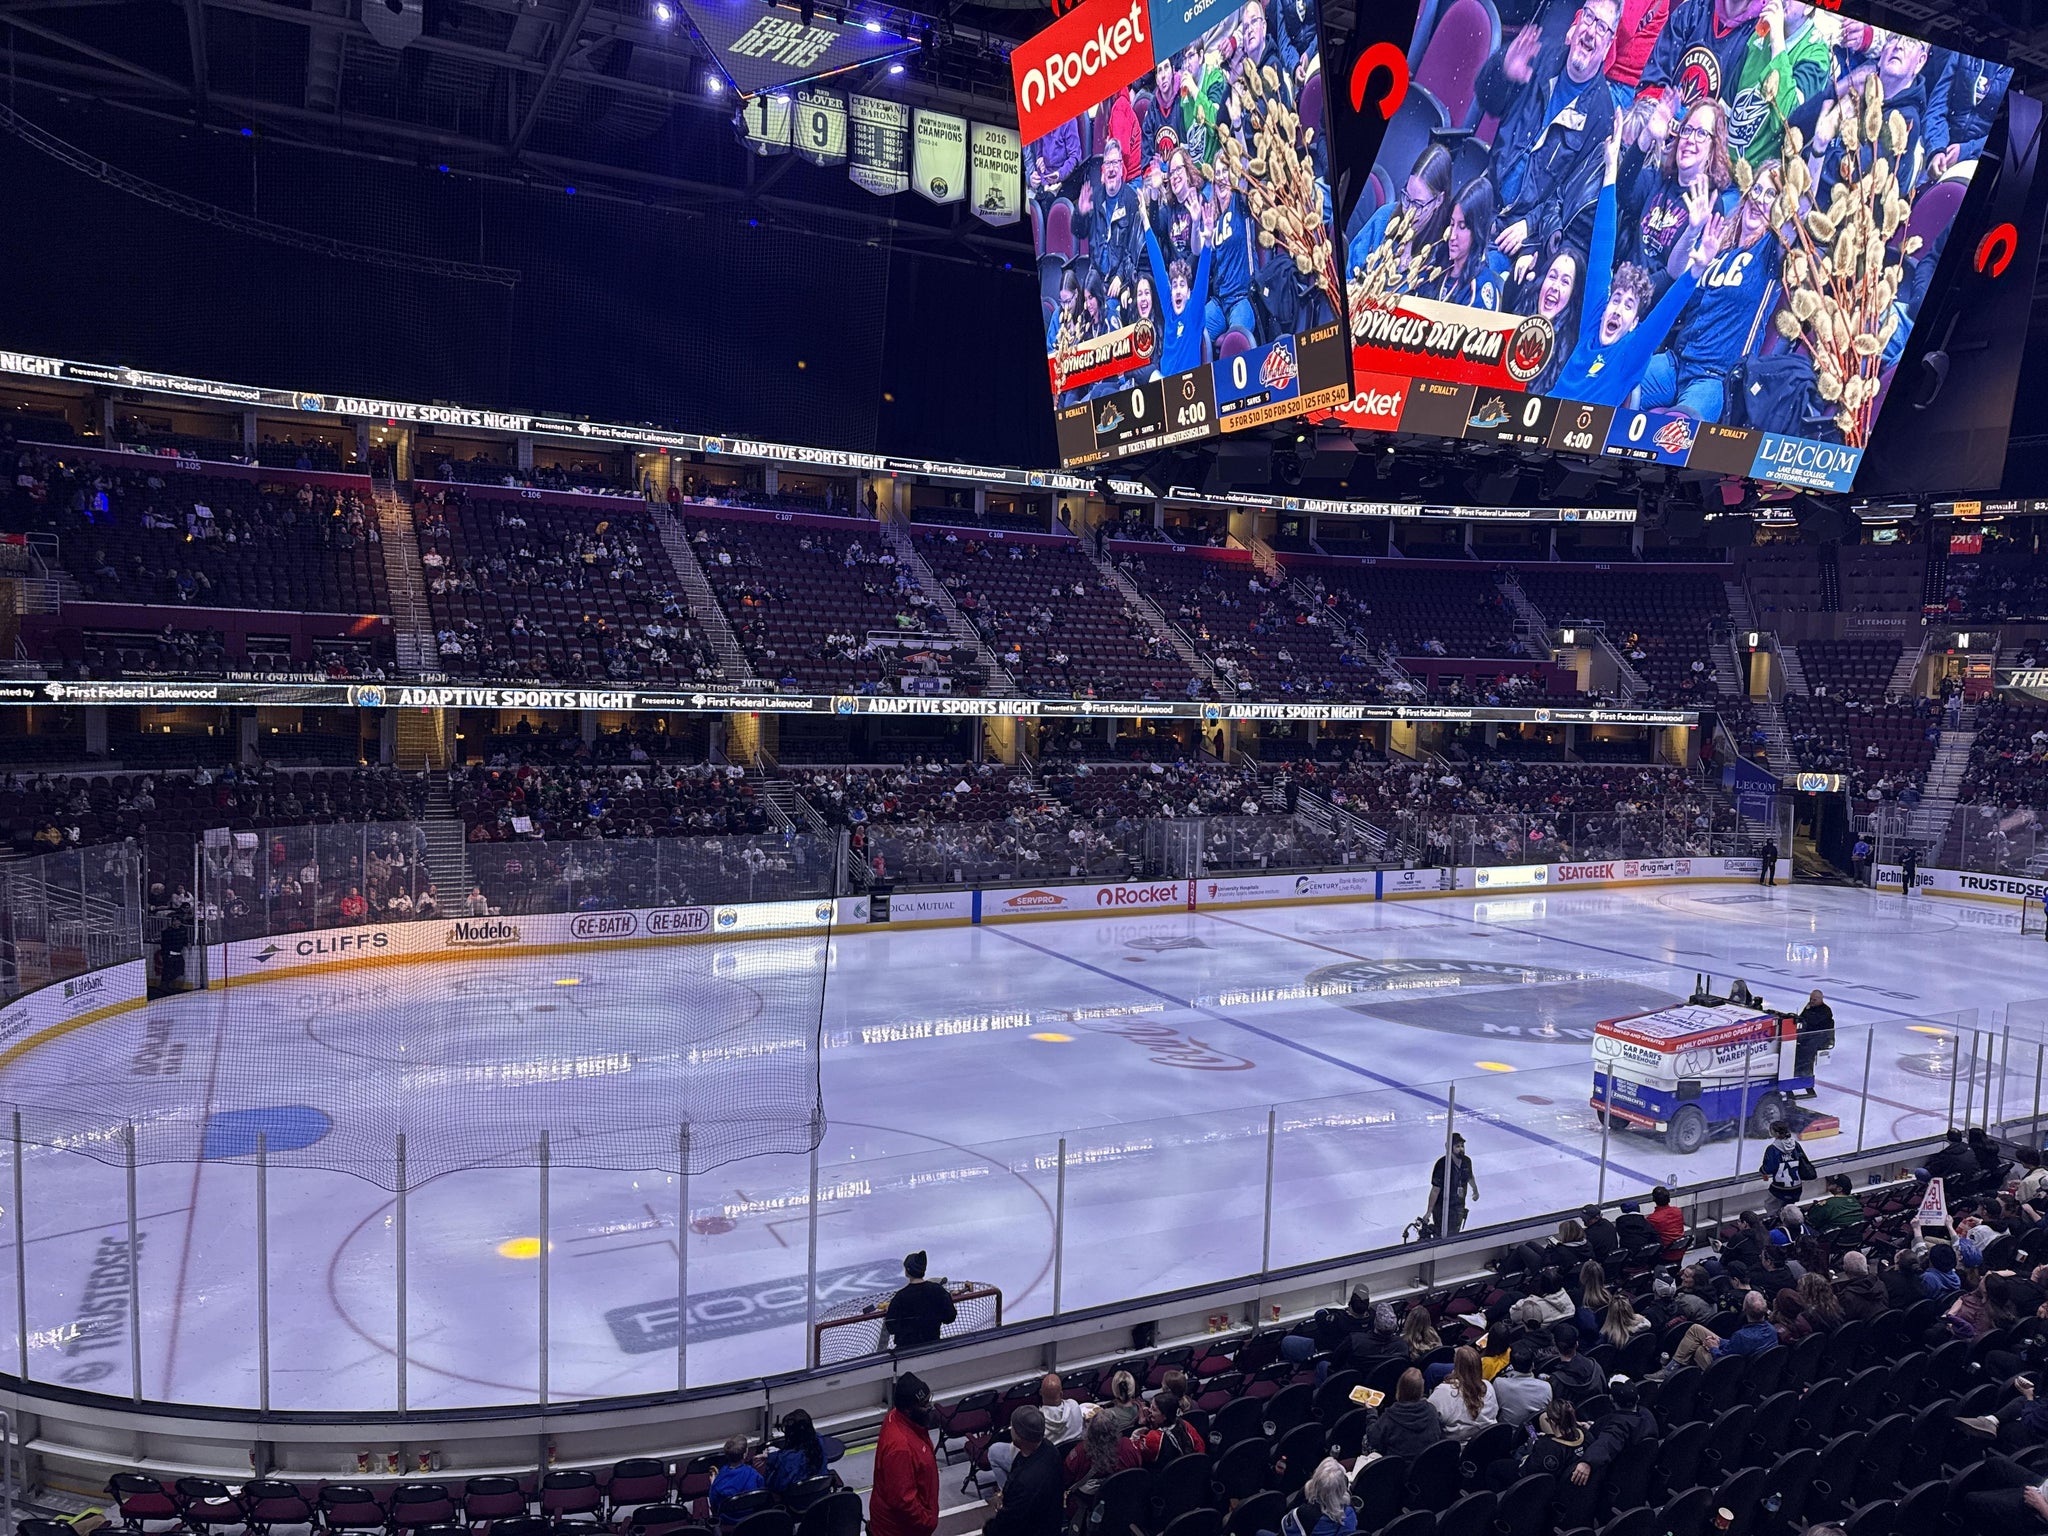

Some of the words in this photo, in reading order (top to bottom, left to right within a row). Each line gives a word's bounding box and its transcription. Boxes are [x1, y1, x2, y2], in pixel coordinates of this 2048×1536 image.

[1184, 7, 1193, 23] OF
[753, 16, 804, 38] FEAR
[804, 27, 841, 47] THE
[728, 28, 827, 68] DEPTHS
[1046, 2, 1145, 100] Rocket
[1685, 52, 1718, 91] CLEVELAND
[798, 91, 844, 108] GLOVER
[852, 97, 907, 115] CLEVELAND
[861, 108, 898, 122] BARONS
[812, 112, 828, 147] 9
[920, 117, 937, 127] NORTH
[938, 121, 961, 132] DIVISION
[918, 125, 963, 143] CHAMPIONS
[986, 132, 1007, 145] 2016
[974, 144, 1002, 159] CALDER
[1004, 150, 1019, 162] CUP
[974, 157, 1018, 175] CHAMPIONS
[1311, 325, 1339, 343] PENALTY
[1355, 310, 1429, 346] DYNGUS
[1425, 322, 1466, 351] DAY
[1463, 328, 1503, 358] CAM
[1520, 318, 1552, 339] CLEVELAND
[1063, 350, 1094, 374] DYNGUS
[1096, 345, 1111, 363] DAY
[1112, 338, 1131, 357] CAM
[1, 354, 64, 376] NIGHT
[70, 367, 107, 379] Presented
[109, 372, 118, 381] by
[143, 376, 168, 388] First
[169, 378, 207, 392] Federal
[209, 384, 260, 400] Lakewood
[1233, 356, 1247, 389] 0
[1510, 359, 1540, 378] MONSTERS
[1430, 385, 1459, 397] PENALTY
[1066, 406, 1087, 419] PENALTY
[1132, 389, 1145, 419] 0
[1230, 418, 1234, 428] 5
[1235, 414, 1248, 426] FOR
[1249, 411, 1260, 424] $10
[1264, 408, 1273, 420] 50
[1274, 404, 1287, 417] FOR
[1288, 400, 1300, 415] $20
[1305, 397, 1316, 409] 125
[1318, 394, 1331, 406] FOR
[1332, 388, 1346, 402] $40
[1523, 397, 1542, 427] 0
[335, 399, 417, 419] ADAPTIVE
[420, 407, 481, 426] SPORTS
[484, 414, 531, 431] NIGHT
[536, 422, 564, 431] Presented
[565, 425, 572, 433] by
[591, 426, 610, 437] First
[612, 428, 642, 440] Federal
[642, 431, 684, 445] Lakewood
[1178, 402, 1206, 426] 4:00
[1629, 414, 1647, 442] 0
[1720, 429, 1748, 440] PENALTY
[1128, 442, 1146, 453] TICKETS
[1563, 431, 1593, 449] 4:00
[184, 462, 201, 471] 105
[733, 442, 797, 460] ADAPTIVE
[798, 450, 847, 465] SPORTS
[849, 455, 887, 469] NIGHT
[933, 465, 948, 474] First
[949, 467, 973, 477] Federal
[973, 469, 1006, 479] Lakewood
[1084, 452, 1102, 463] RAFFLE
[1766, 471, 1773, 479] OF
[1774, 473, 1809, 485] OSTEOPATHIC
[1809, 479, 1835, 488] MEDICINE
[1778, 466, 1791, 474] LAKE
[1804, 470, 1826, 480] COLLEGE
[528, 491, 542, 499] 106
[1304, 501, 1349, 513] ADAPTIVE
[1350, 504, 1389, 515] SPORTS
[1391, 506, 1422, 516] NIGHT
[1462, 508, 1474, 516] First
[1475, 509, 1497, 517] Federal
[1986, 501, 2017, 511] oswald
[1563, 630, 1574, 644] M
[1958, 633, 1969, 648] N
[23, 688, 35, 698] by
[66, 687, 96, 698] First
[99, 687, 148, 698] Federal
[150, 687, 218, 699] Lakewood
[399, 689, 497, 706] ADAPTIVE
[501, 691, 576, 708] SPORTS
[580, 693, 636, 709] NIGHT
[642, 697, 674, 705] Presented
[675, 698, 685, 706] by
[707, 697, 729, 707] First
[730, 697, 765, 708] Federal
[766, 699, 813, 709] Lakewood
[868, 699, 941, 714] ADAPTIVE
[943, 700, 997, 714] SPORTS
[999, 701, 1041, 715] NIGHT
[1092, 705, 1109, 713] First
[1110, 705, 1137, 714] Federal
[1137, 706, 1173, 714] Lakewood
[1229, 706, 1285, 718] ADAPTIVE
[1286, 707, 1330, 719] SPORTS
[1331, 708, 1365, 719] NIGHT
[1617, 713, 1645, 721] Federal
[1645, 714, 1684, 722] Lakewood
[1736, 780, 1776, 792] LECOM
[1558, 864, 1615, 881] SEATGEEK
[1640, 864, 1657, 873] drug
[1657, 863, 1674, 871] mart
[1017, 896, 1055, 905] SERVPRO
[1115, 885, 1178, 905] Rocket
[917, 902, 954, 911] MUTUAL
[578, 917, 631, 935] RE-BATH
[653, 912, 703, 930] RE-BATH
[455, 921, 511, 942] Modelo
[296, 932, 389, 956] CLIFFS
[1597, 1023, 1613, 1031] FAMILY
[1613, 1028, 1630, 1036] OWNED
[1641, 1035, 1666, 1046] OPERATED
[1676, 1040, 1697, 1051] FAMILY
[1697, 1035, 1719, 1046] OWNED
[1720, 1031, 1732, 1040] AND
[1623, 1044, 1639, 1054] CAR
[1639, 1049, 1662, 1061] PARTS
[1623, 1051, 1660, 1066] WAREHOUSE
